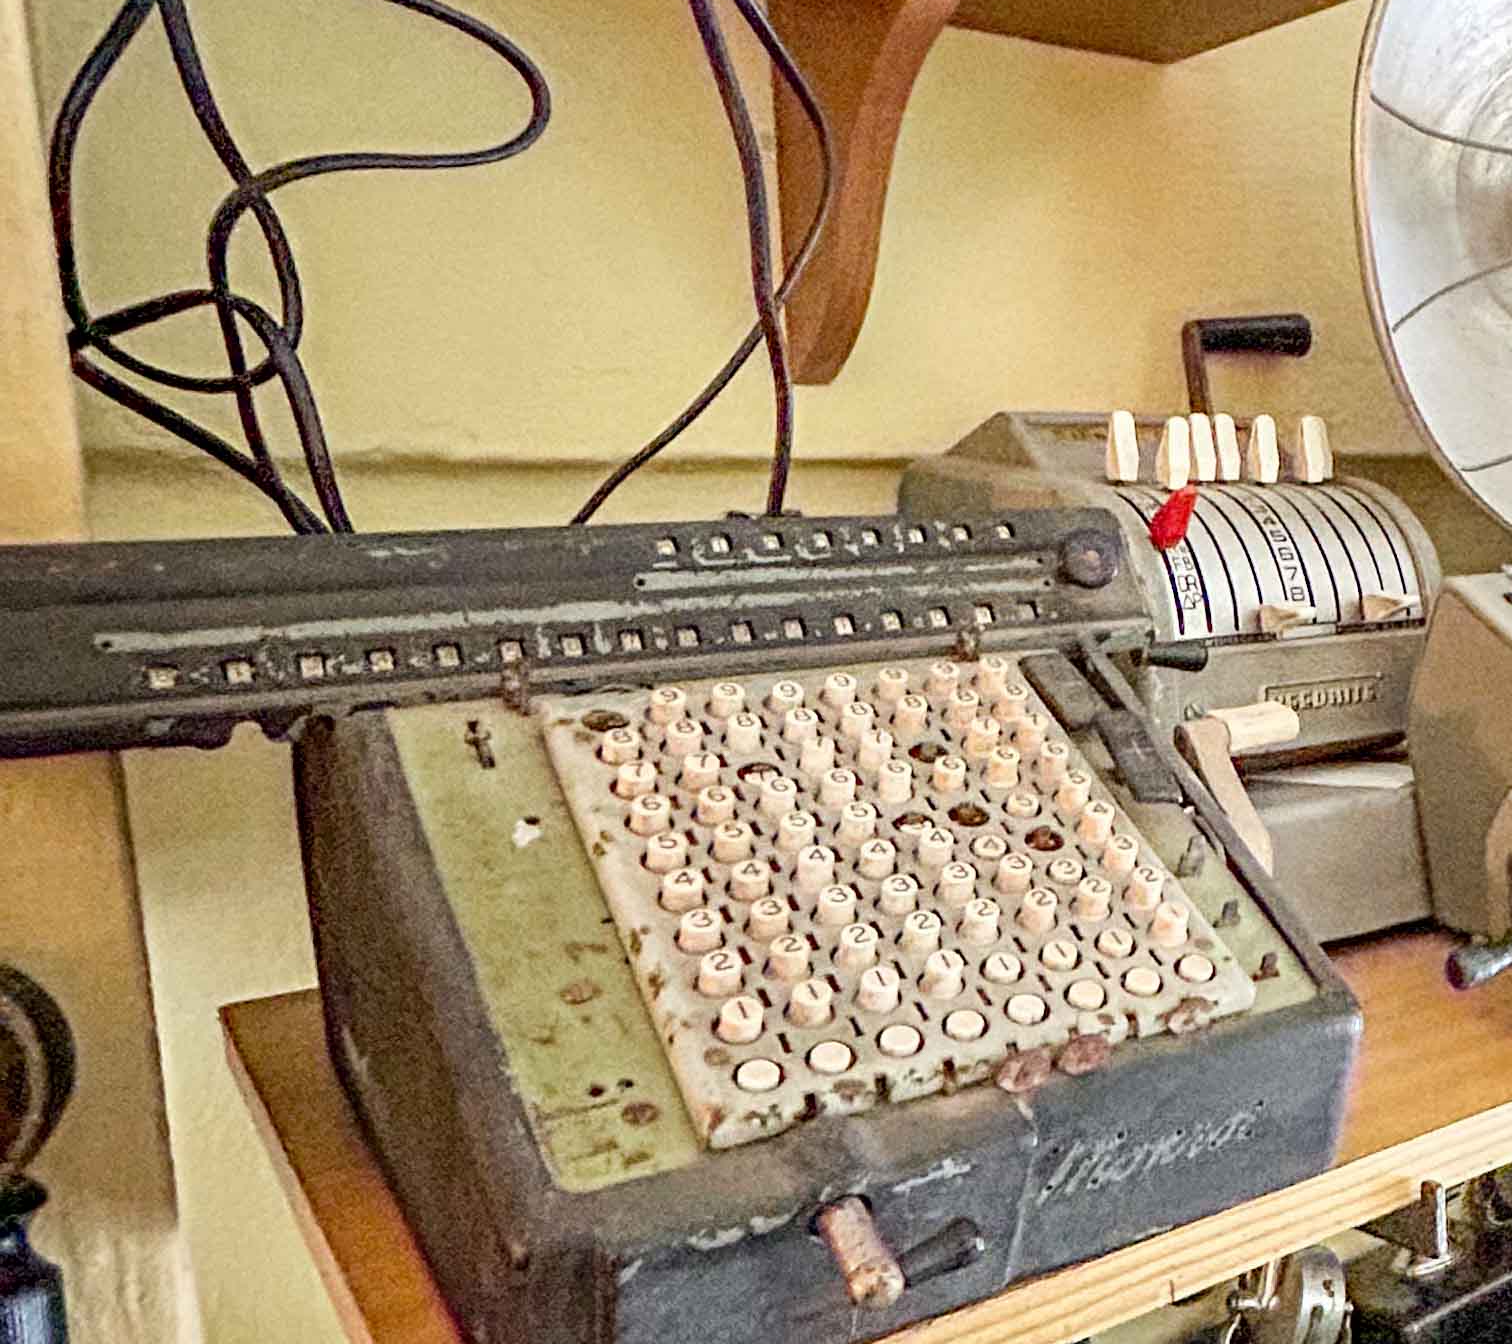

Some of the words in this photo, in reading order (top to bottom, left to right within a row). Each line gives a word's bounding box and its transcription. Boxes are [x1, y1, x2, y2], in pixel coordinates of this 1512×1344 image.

[1270, 530, 1287, 542] 5
[1279, 547, 1294, 561] 6
[1284, 566, 1297, 581] 7
[1290, 587, 1305, 602] 8
